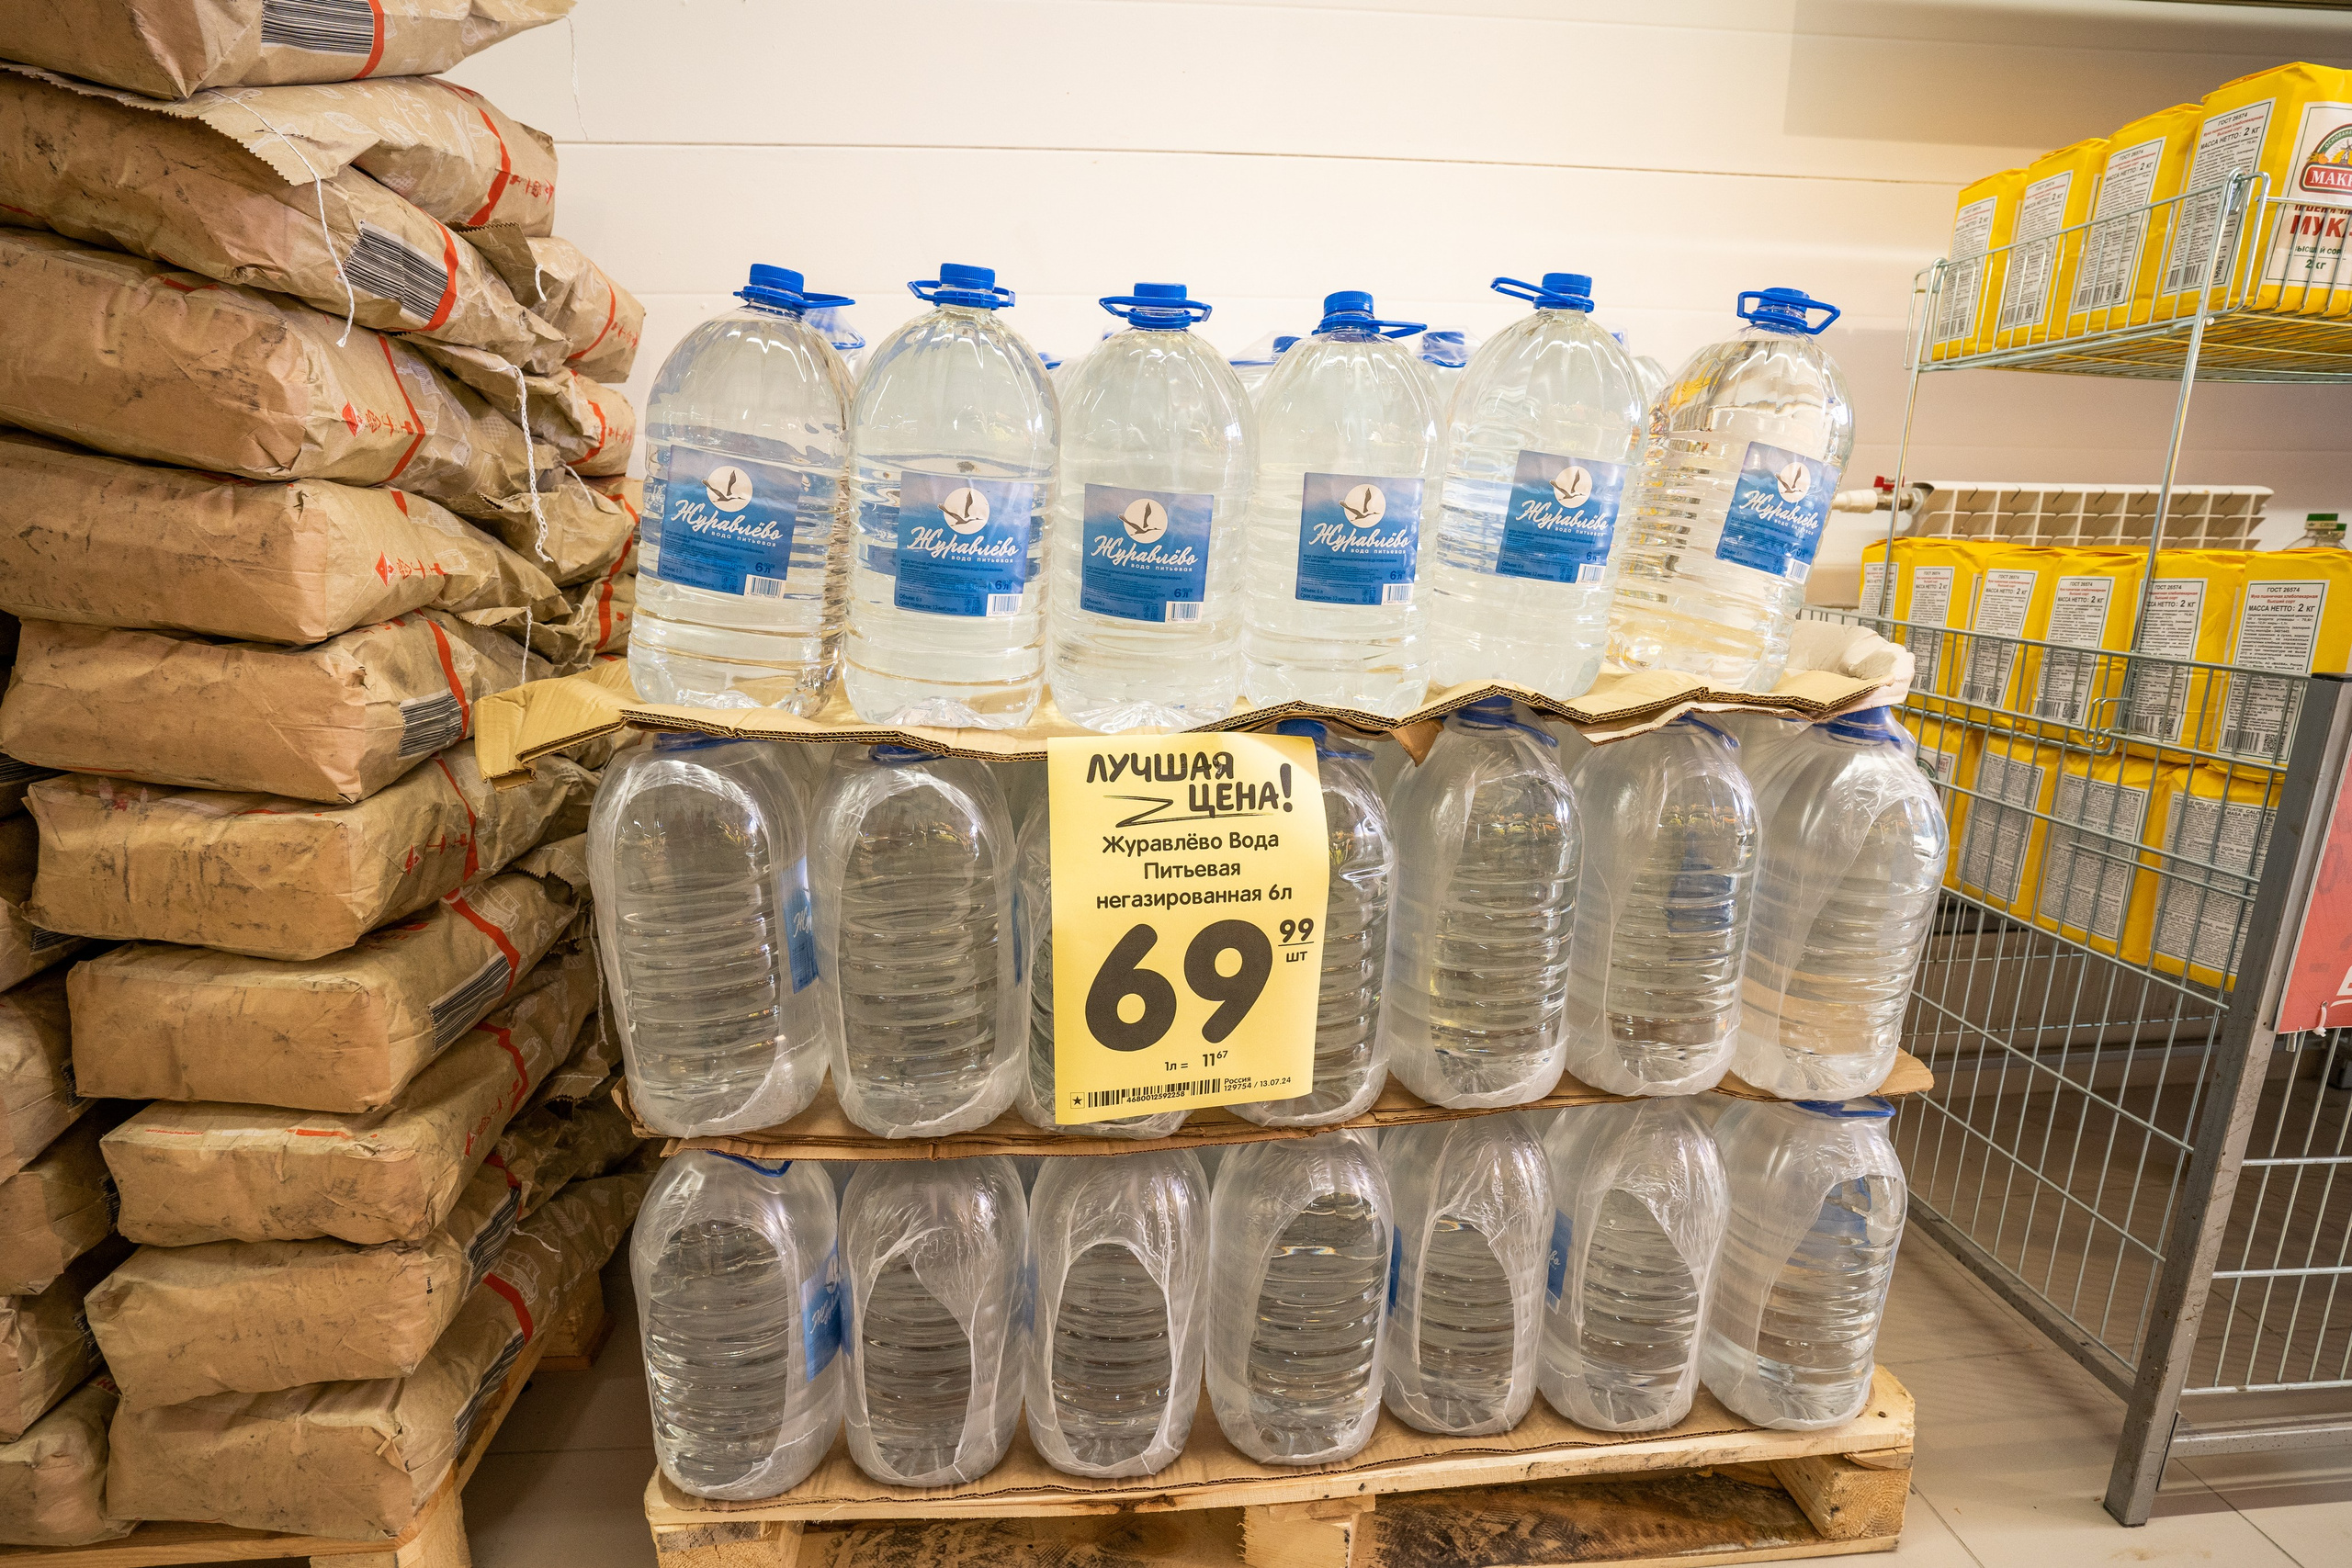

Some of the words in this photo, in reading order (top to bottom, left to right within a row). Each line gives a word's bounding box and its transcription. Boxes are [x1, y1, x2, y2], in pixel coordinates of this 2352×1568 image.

[2244, 128, 2249, 136] 2
[2290, 215, 2352, 238] МУК
[2305, 259, 2312, 269] 2
[1516, 500, 1609, 530] Журавлёво
[1739, 490, 1819, 530] Журавлёво
[671, 499, 784, 541] Журавлёво
[1774, 519, 1789, 527] вода
[711, 531, 732, 539] вода
[737, 536, 776, 547] питьевая
[907, 526, 1019, 558] Журавлёво
[1309, 523, 1410, 552] Журавлёво
[1091, 536, 1198, 567] Журавлёво
[1587, 551, 1592, 561] 6
[755, 562, 763, 572] 6
[763, 566, 771, 574] л
[1390, 570, 1396, 581] 6
[995, 580, 1002, 591] 6
[1174, 588, 1182, 598] 6
[2298, 604, 2304, 612] 2
[1086, 751, 1234, 783] ЛУЧШАЯ
[1189, 762, 1293, 818] ЦЕНА!
[1102, 832, 1223, 857] Журавлёво
[1229, 831, 1279, 851] Вода
[1144, 862, 1241, 879] Питьевая
[1096, 888, 1262, 910] негазированная
[1269, 884, 1292, 900] 6л
[1286, 951, 1307, 963] шт
[1085, 919, 1273, 1052] 69
[1279, 918, 1314, 942] 99
[1164, 1061, 1177, 1071] 1л
[1224, 1077, 1251, 1085] Россия
[1224, 1082, 1252, 1091] 129754
[1260, 1077, 1291, 1088] 13.07.24
[1126, 1090, 1185, 1103] 4680012592258
